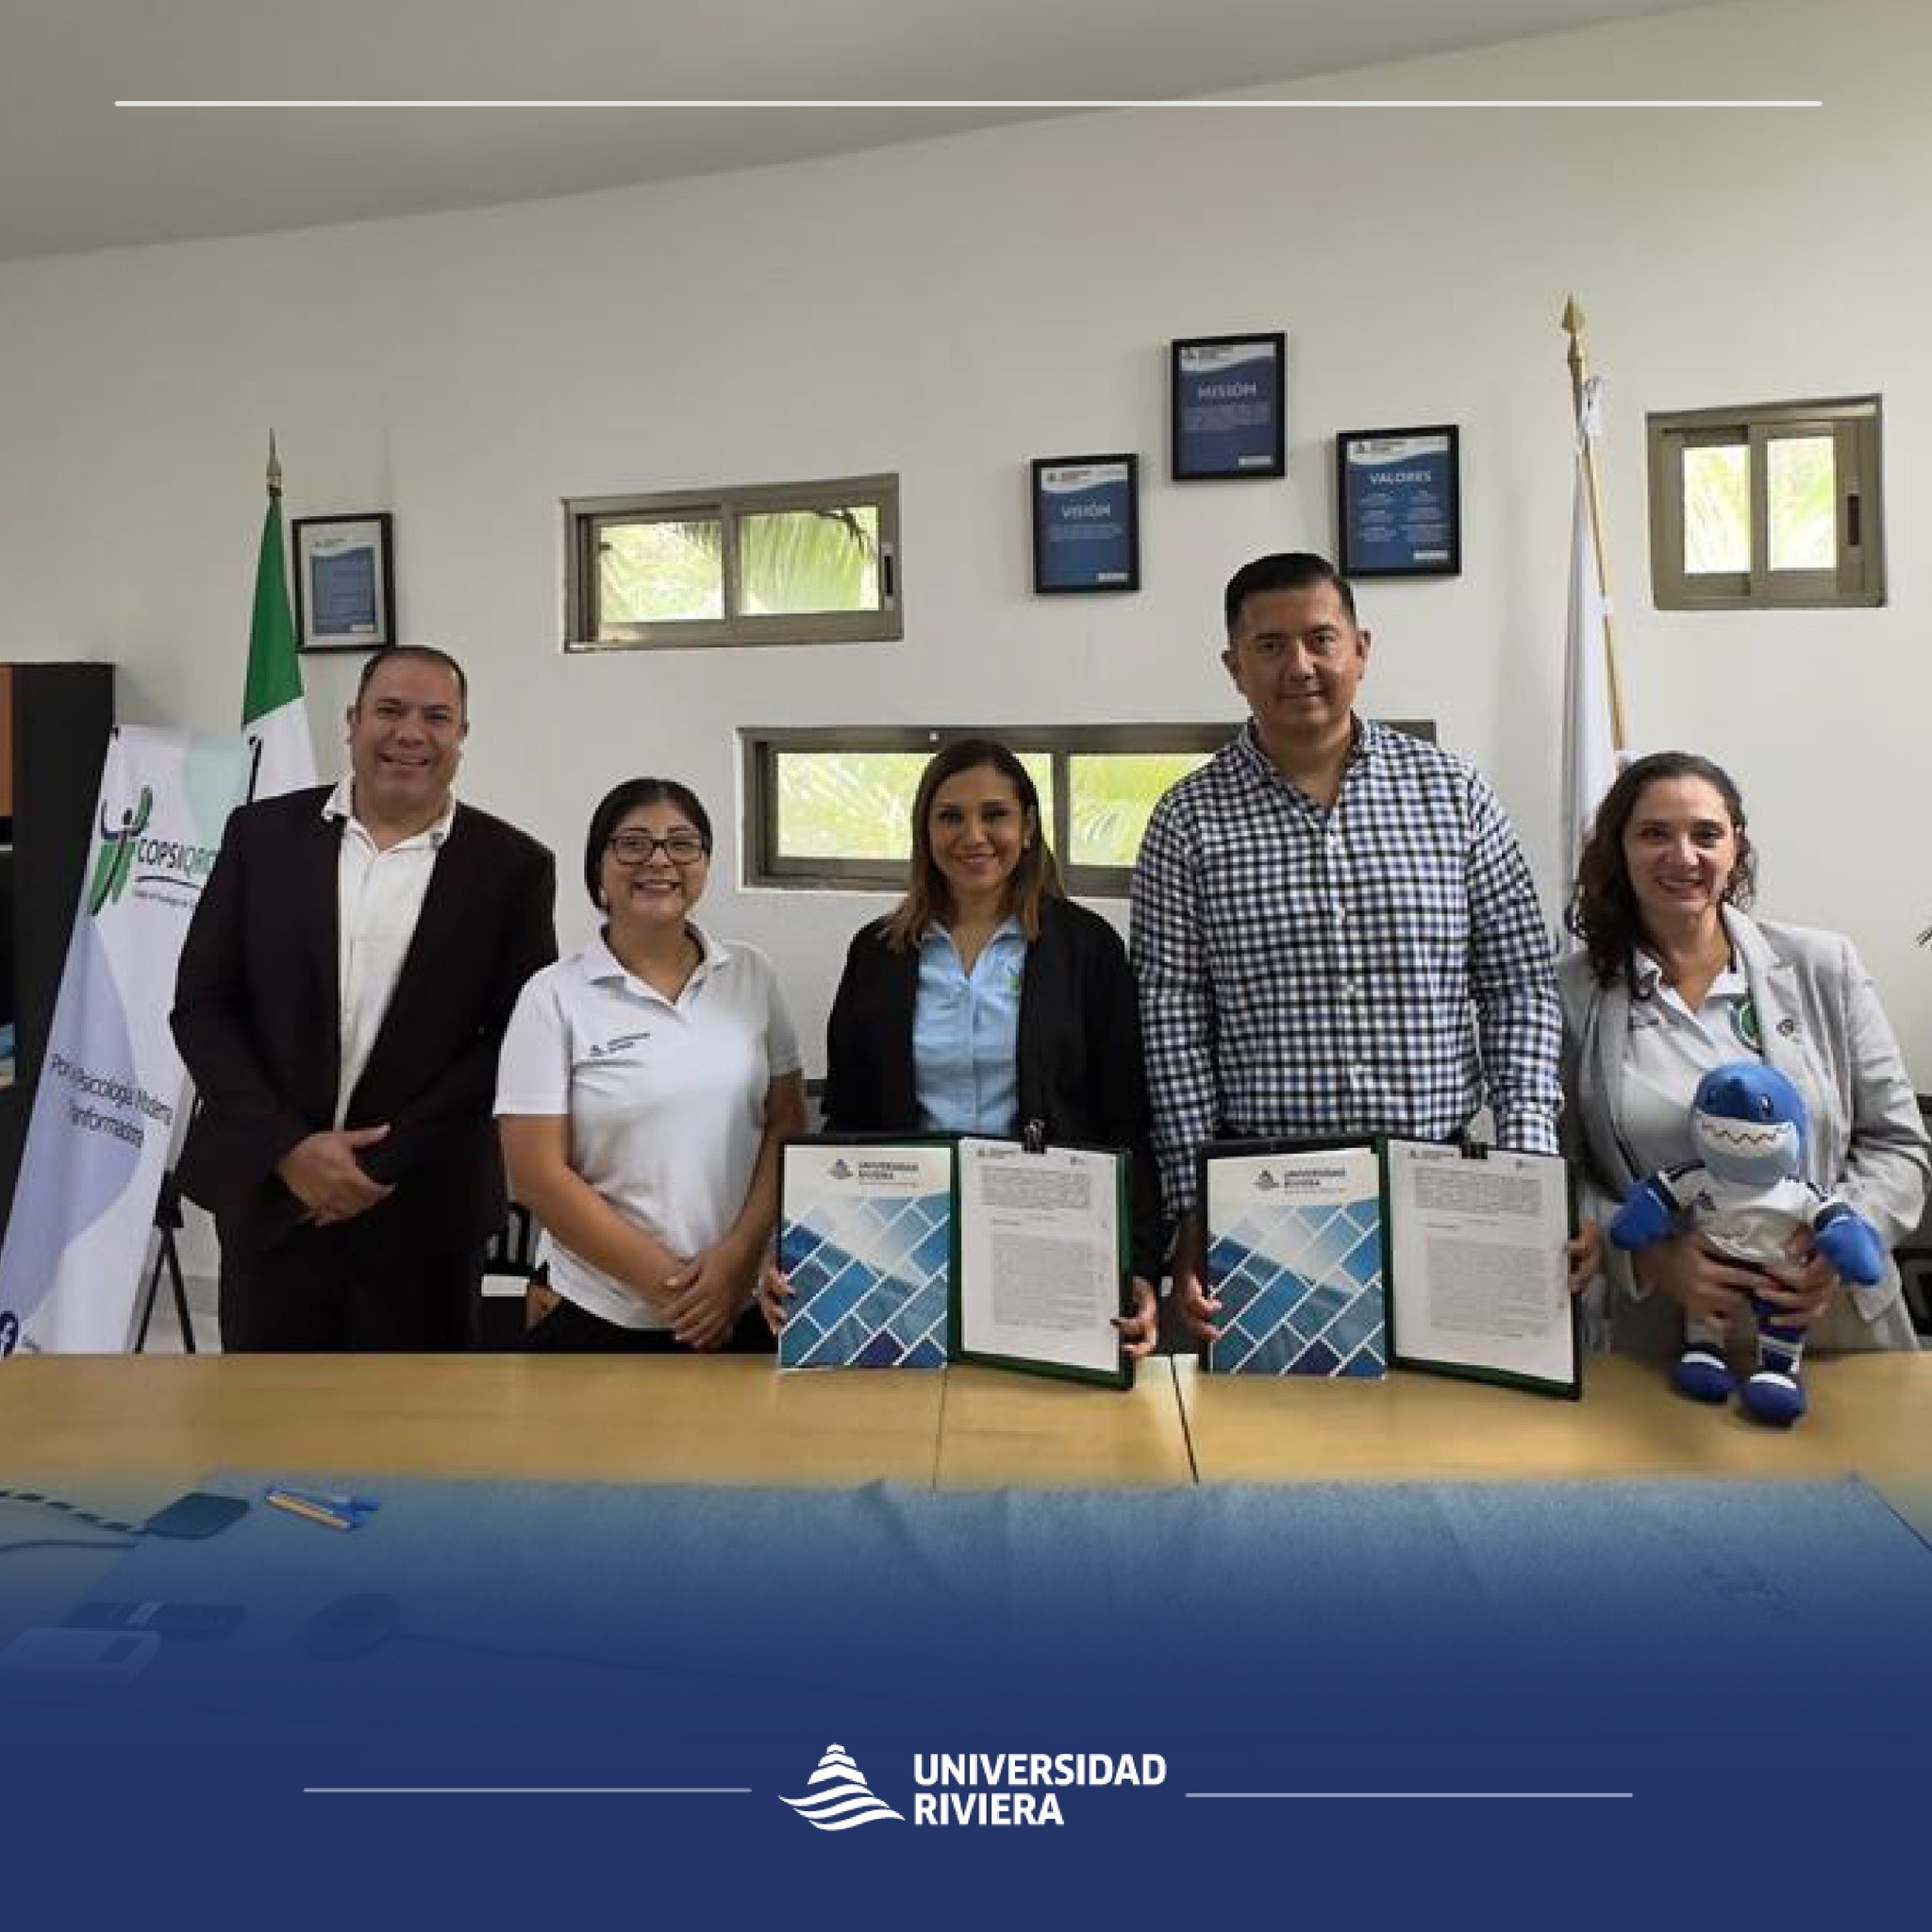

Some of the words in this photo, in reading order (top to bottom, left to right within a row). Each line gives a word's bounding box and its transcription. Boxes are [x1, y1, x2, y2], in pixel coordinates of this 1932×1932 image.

[1197, 381, 1257, 399] MISIÓN
[1370, 470, 1432, 485] VALORES
[1059, 500, 1111, 519] VISIÓN
